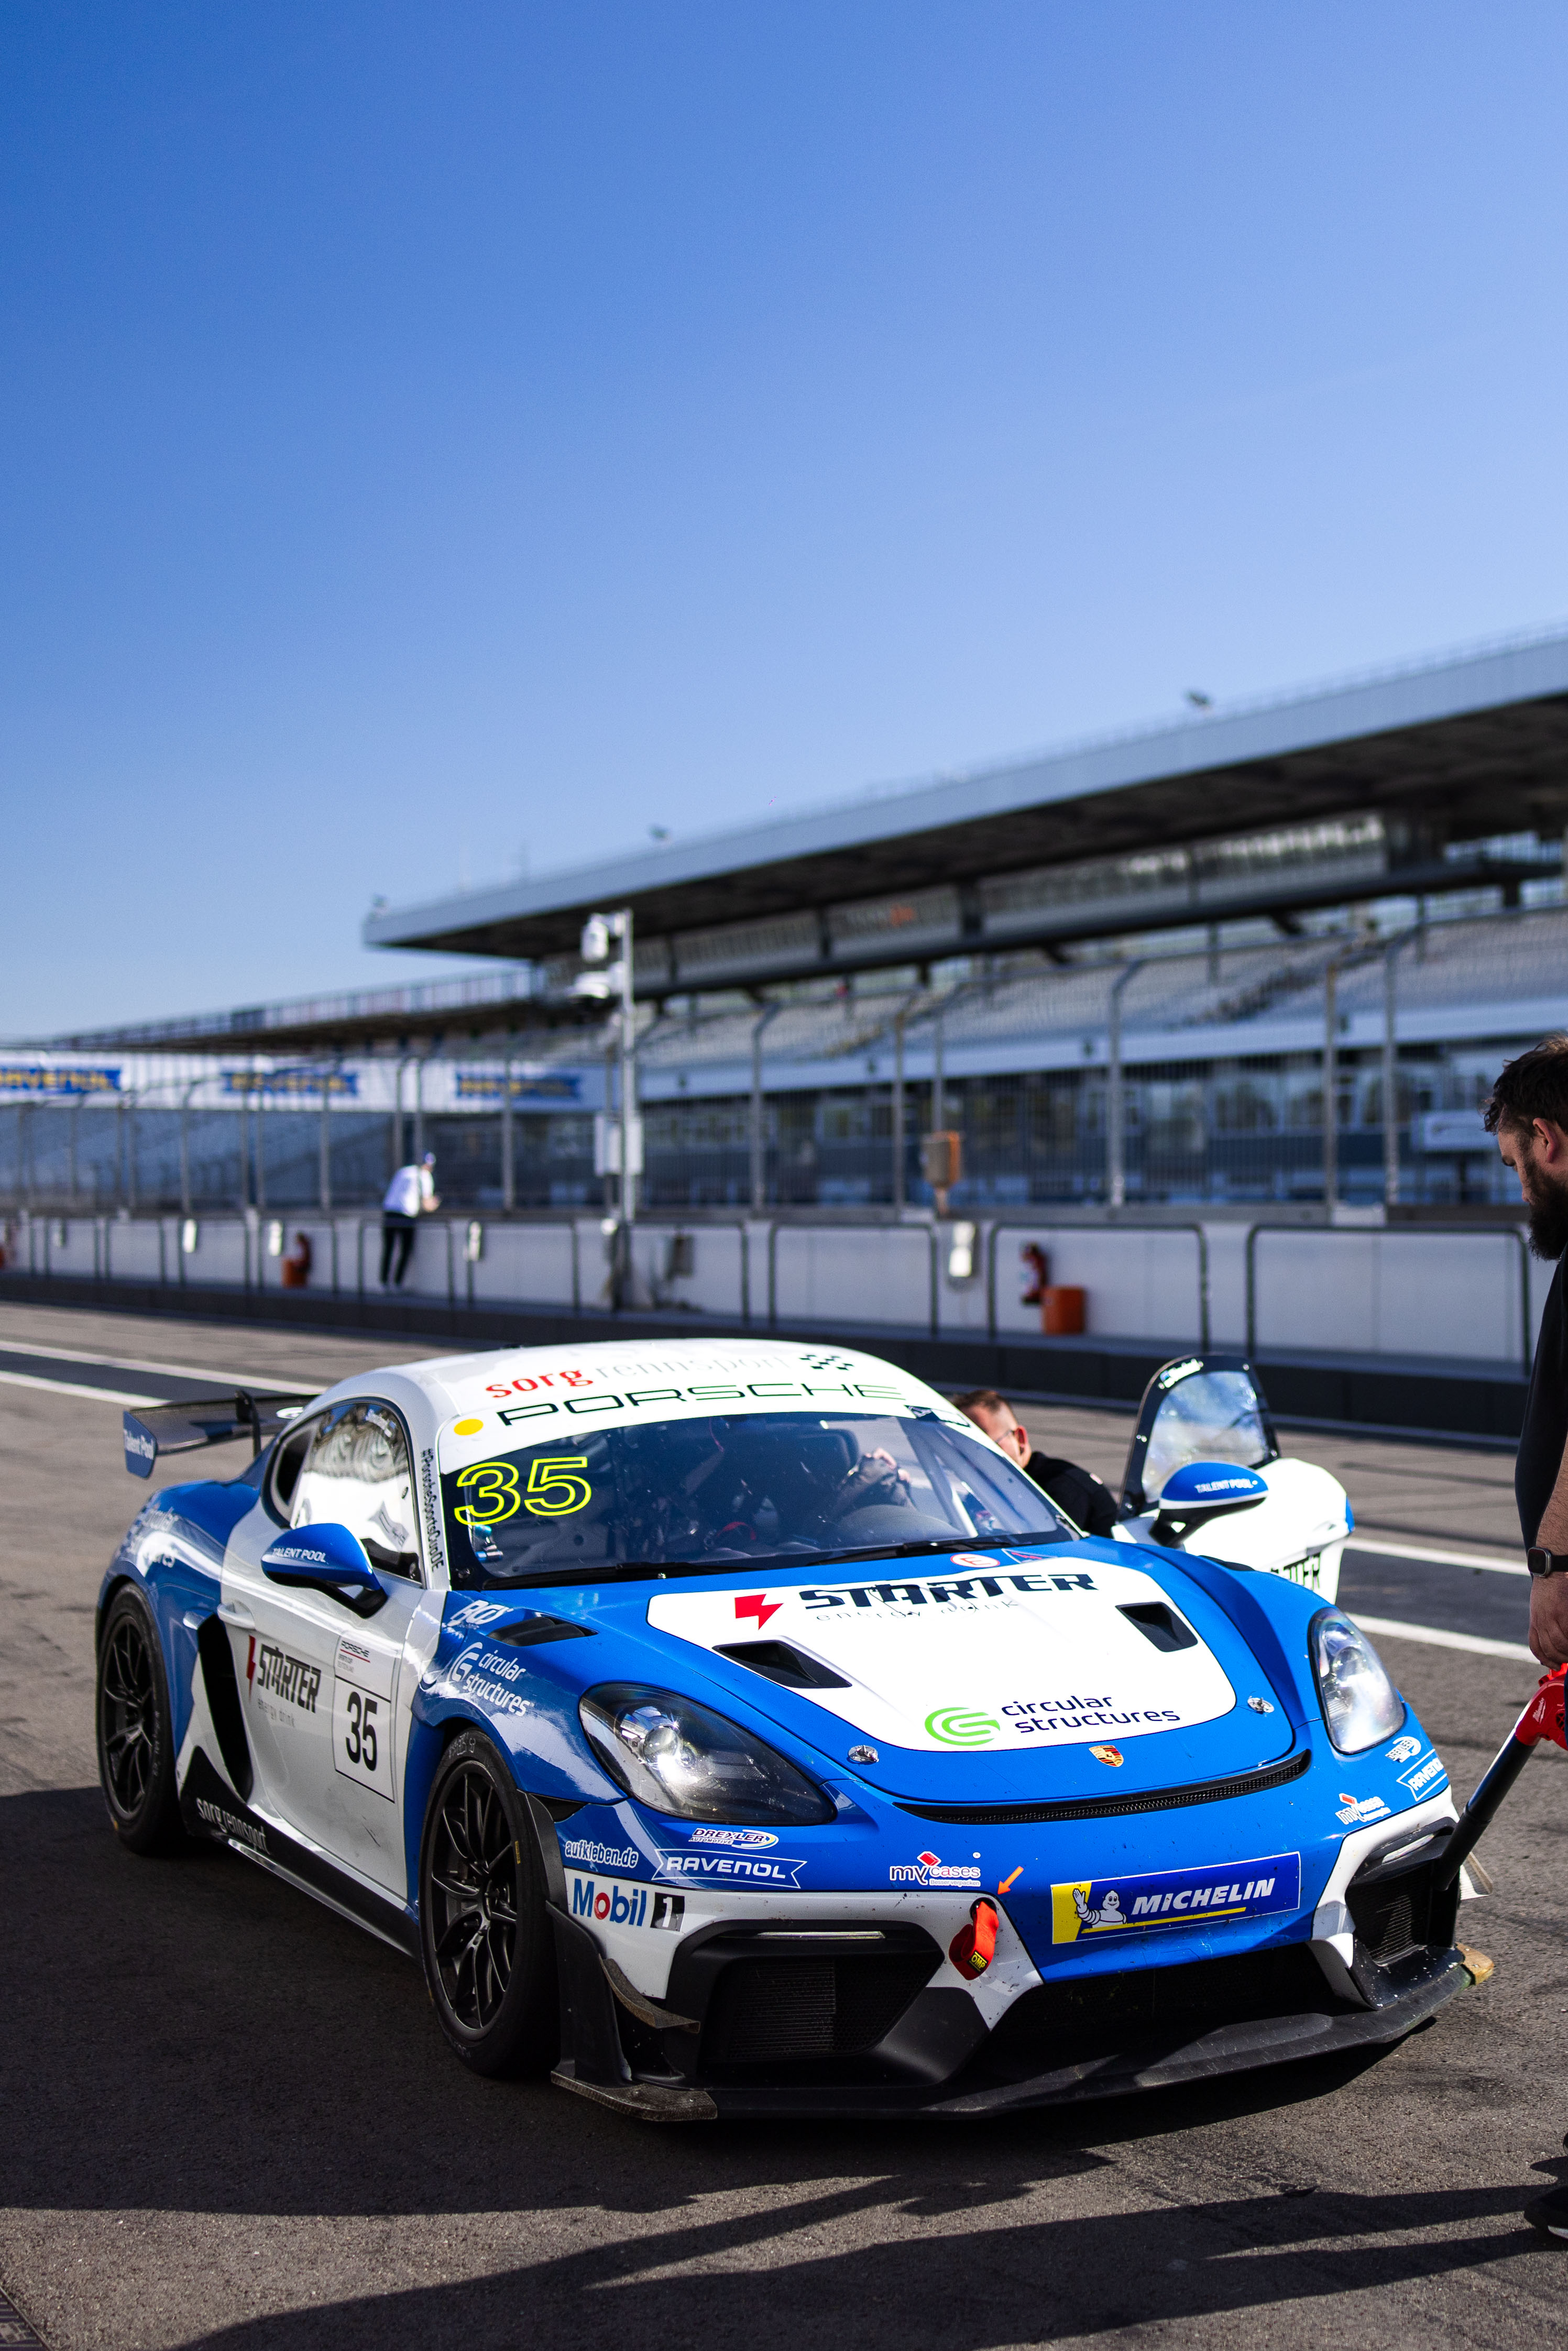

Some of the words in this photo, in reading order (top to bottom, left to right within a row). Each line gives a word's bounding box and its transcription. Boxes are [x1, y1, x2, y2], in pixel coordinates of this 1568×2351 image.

[486, 1369, 594, 1398] sorg
[596, 1356, 791, 1379] rennsport
[497, 1383, 906, 1426] PORSCHE
[454, 1456, 592, 1526] 35
[301, 1549, 326, 1563] POOL
[798, 1573, 1099, 1610] STARTER
[257, 1643, 322, 1714] STARTER
[478, 1649, 527, 1682] circular
[462, 1673, 531, 1717] structures
[1001, 1695, 1113, 1716] circular
[345, 1691, 378, 1772] 35
[1014, 1710, 1181, 1733] structures
[1407, 1756, 1445, 1791] RAVENO
[196, 1797, 228, 1833] sorg
[693, 1829, 765, 1842] DREXLER
[565, 1840, 639, 1868] aufkleben.de
[666, 1856, 786, 1879] RAVENOL
[573, 1877, 648, 1927] Mobil
[662, 1896, 674, 1928] 1
[1131, 1877, 1276, 1915] MICHELIN
[971, 1954, 985, 1969] OMP
